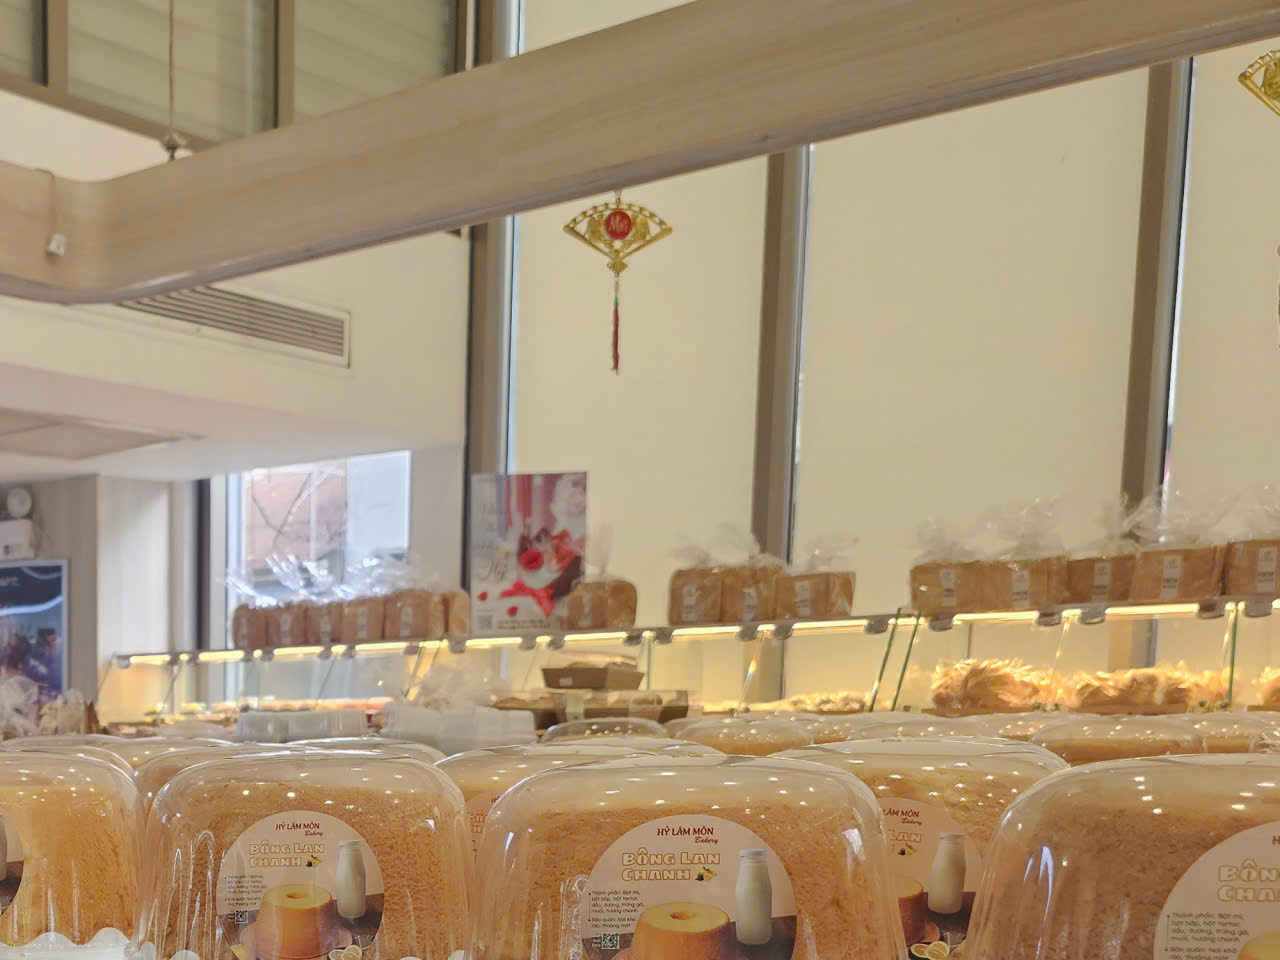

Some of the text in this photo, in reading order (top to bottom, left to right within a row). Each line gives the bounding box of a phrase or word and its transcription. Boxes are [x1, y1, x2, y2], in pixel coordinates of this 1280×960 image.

[672, 826, 691, 836] LÂM
[693, 825, 714, 836] MÔN
[248, 840, 325, 855] BÔNG LAN
[249, 857, 302, 868] CHANH
[622, 847, 720, 866] BÔNG LAN
[622, 868, 691, 881] CHANH
[1218, 857, 1280, 882] BÔN
